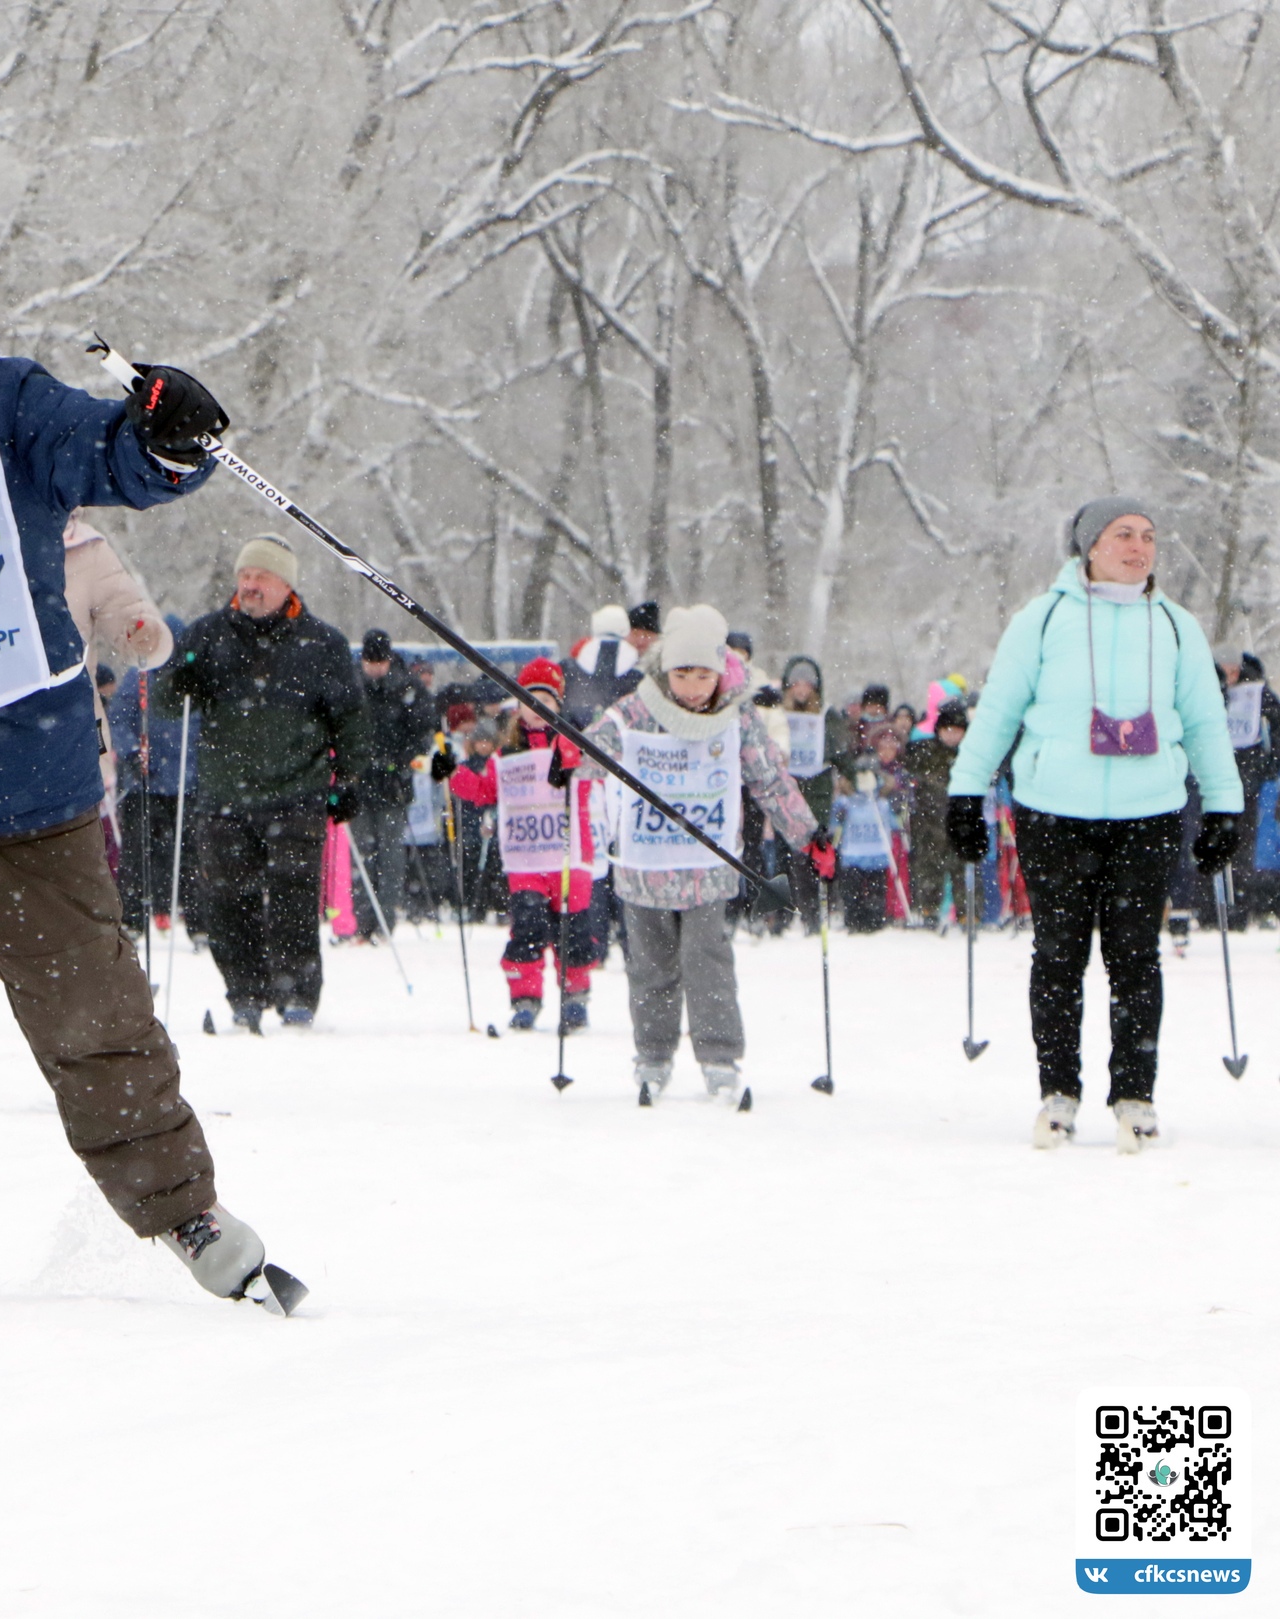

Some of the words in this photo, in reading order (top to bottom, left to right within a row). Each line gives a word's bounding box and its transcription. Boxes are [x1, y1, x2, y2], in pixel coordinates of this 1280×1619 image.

[219, 452, 287, 506] NORDWAY
[371, 575, 399, 597] ACTIVE
[396, 594, 416, 610] XC
[639, 768, 686, 786] 2021
